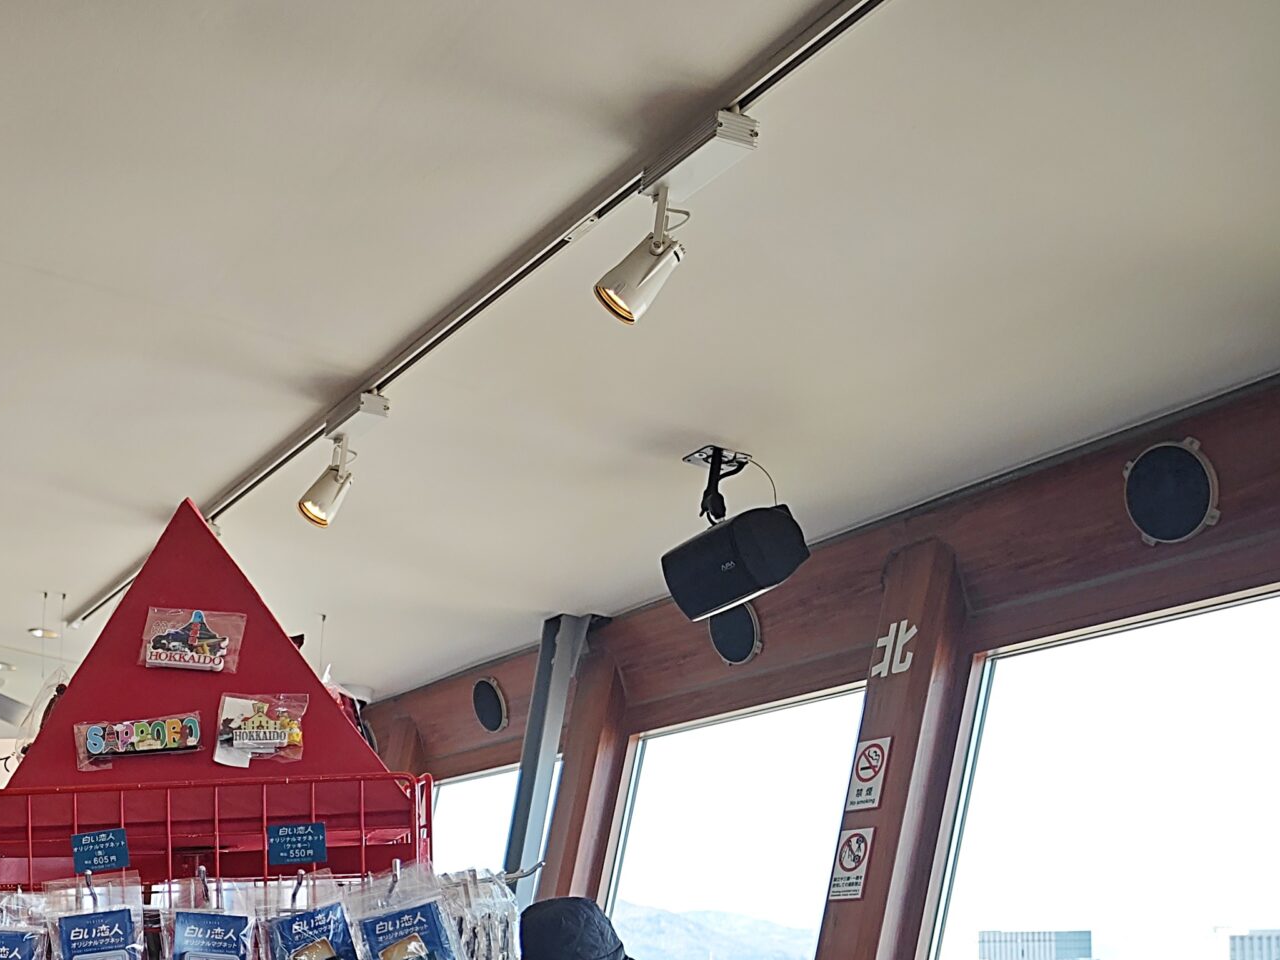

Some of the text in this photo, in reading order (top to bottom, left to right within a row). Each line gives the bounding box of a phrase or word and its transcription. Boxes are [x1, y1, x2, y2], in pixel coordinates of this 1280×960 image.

[871, 619, 918, 678] 北
[148, 651, 223, 665] HOKKAIDO
[86, 716, 200, 755] SAPPORO
[233, 730, 287, 742] HOKKAIDO
[278, 825, 314, 836] 白い恋人
[82, 832, 116, 845] 白い恋人
[269, 834, 324, 844] オリジナルマグネット
[73, 840, 126, 853] オリジナルマグネット
[291, 909, 340, 934] 白い恋人
[375, 911, 427, 935] 白い恋人
[70, 923, 124, 941] 白い恋人
[183, 925, 238, 941] 白い恋人
[71, 936, 125, 949] オリジナルマグネット
[183, 939, 238, 949] オリジナルマグネット
